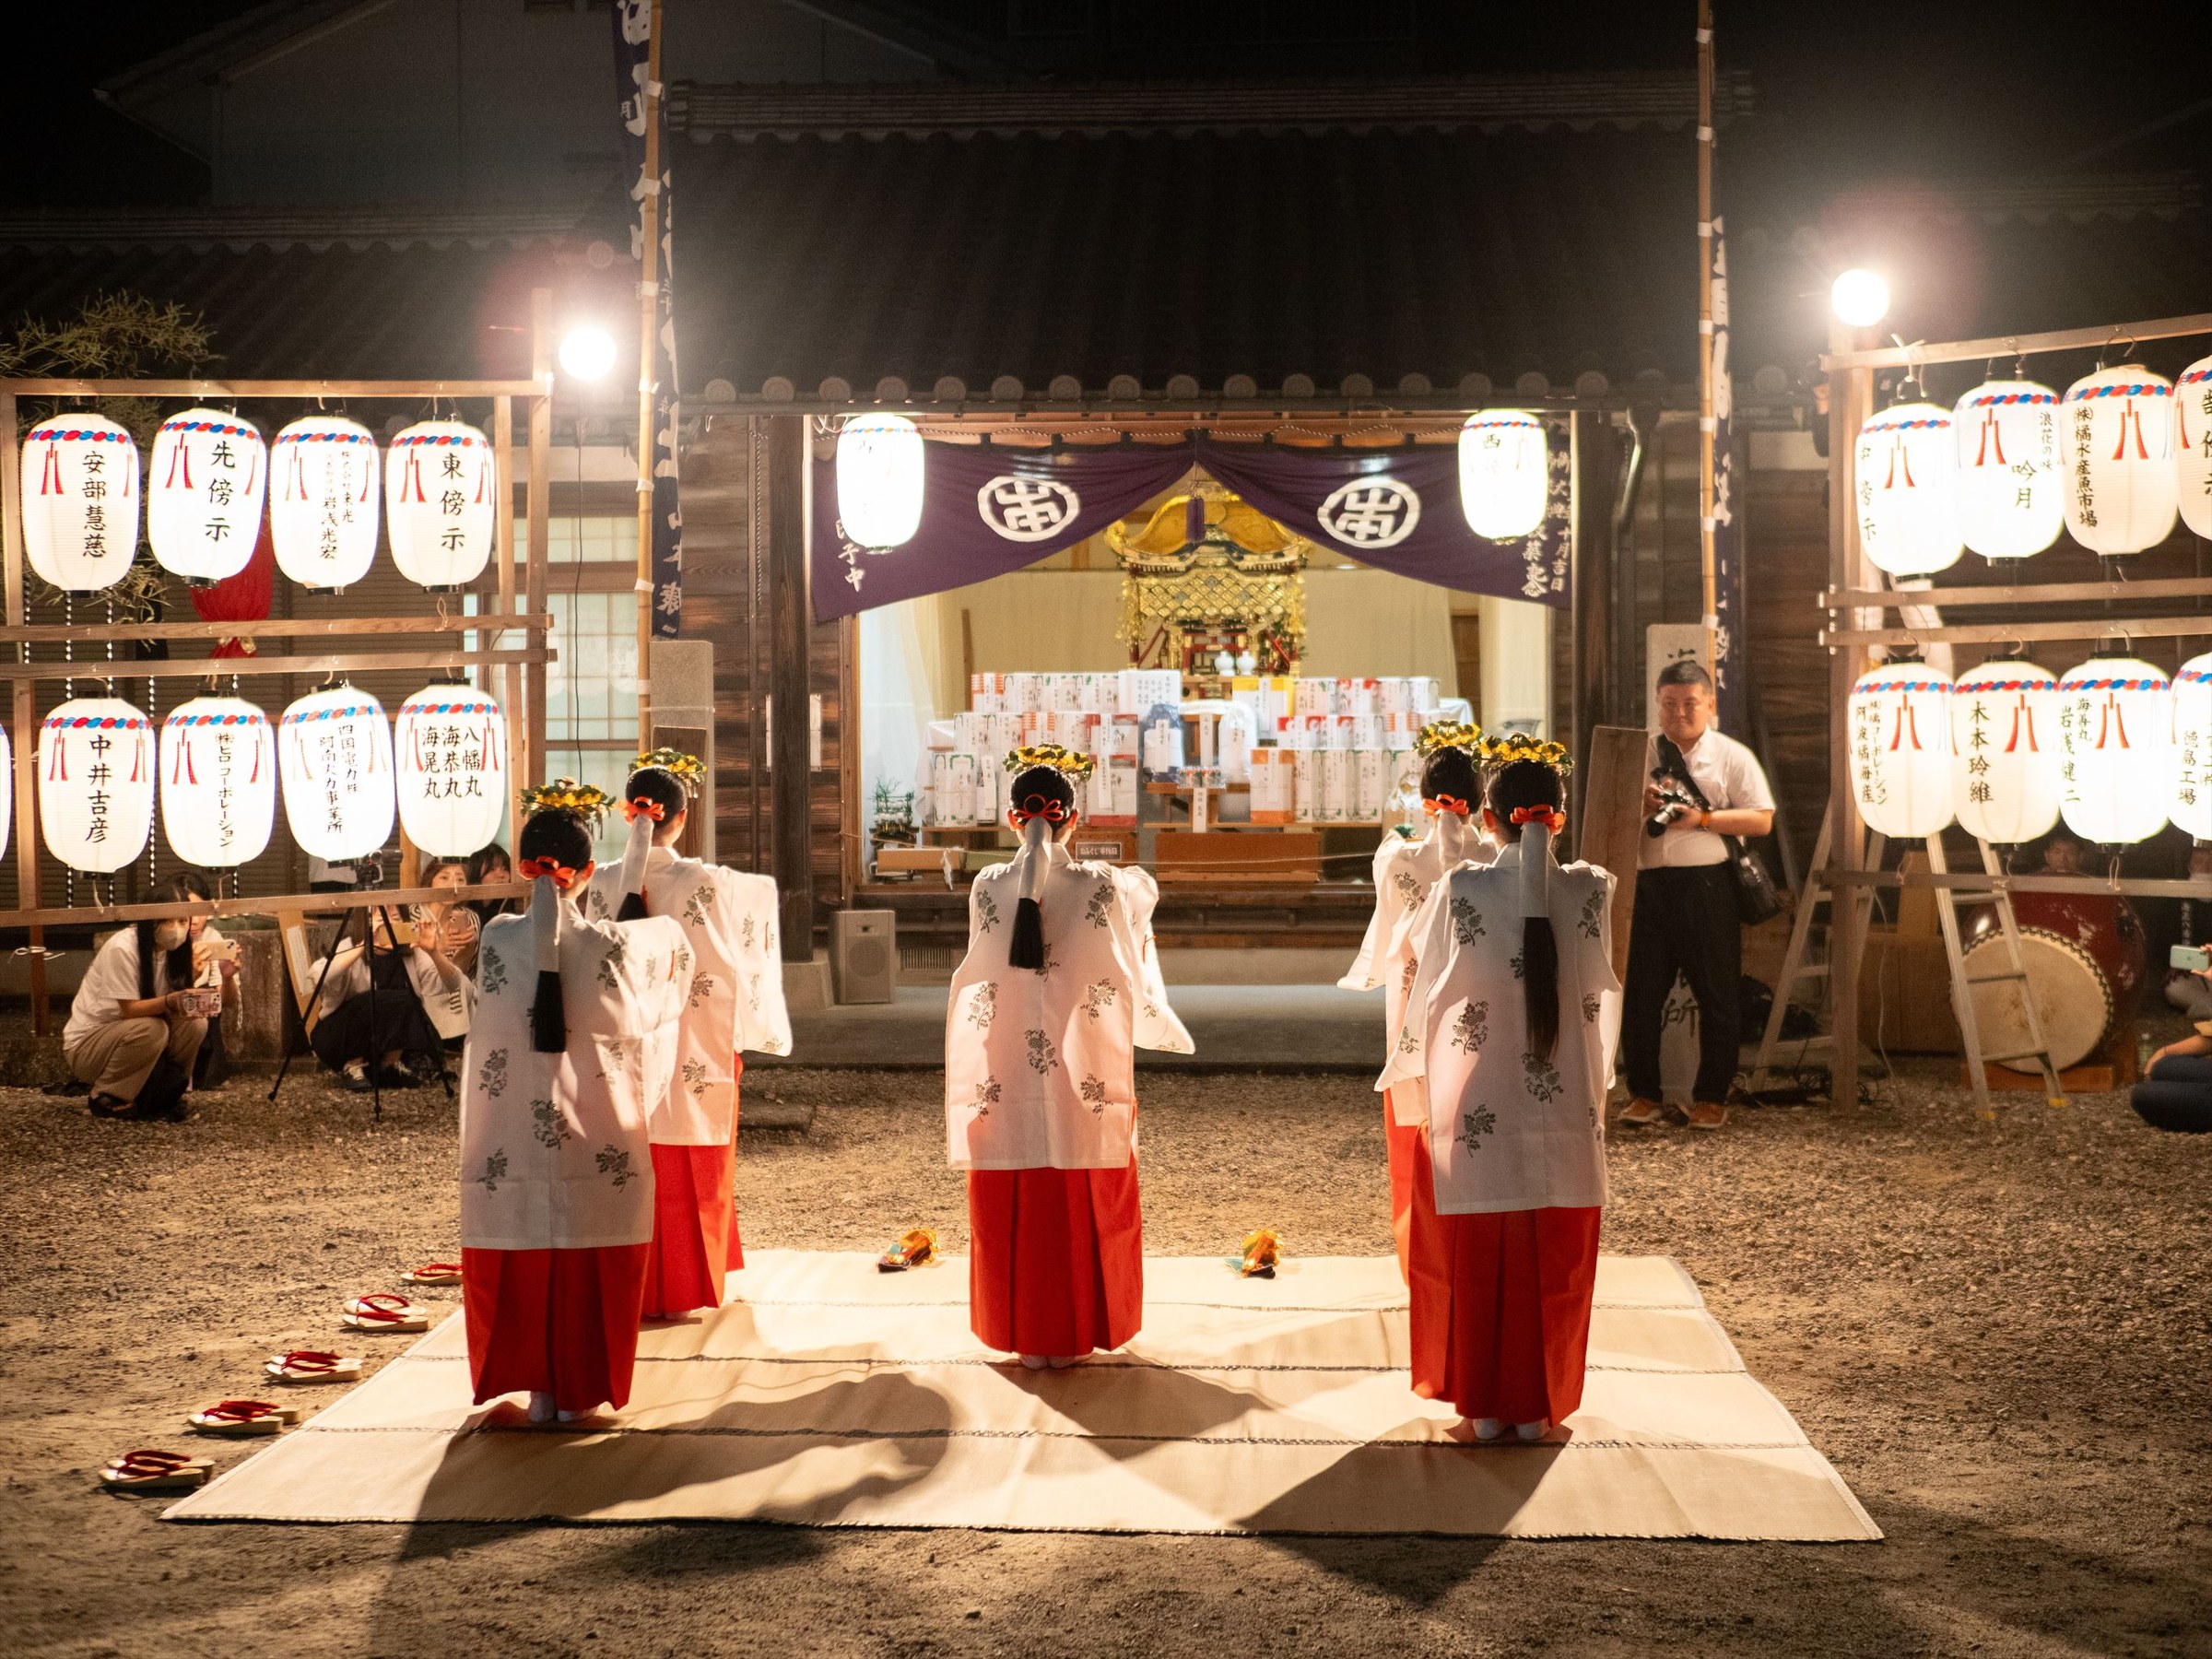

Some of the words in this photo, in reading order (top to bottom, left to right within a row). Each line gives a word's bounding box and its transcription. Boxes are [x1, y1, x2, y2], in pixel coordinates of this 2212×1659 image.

[206, 441, 235, 542] 先傍示
[441, 453, 465, 551] 東傍示
[2011, 460, 2037, 509] 吟月
[86, 735, 112, 843] 中井吉彦
[463, 725, 483, 797] 八幡丸
[2179, 731, 2198, 805] 徳島工場
